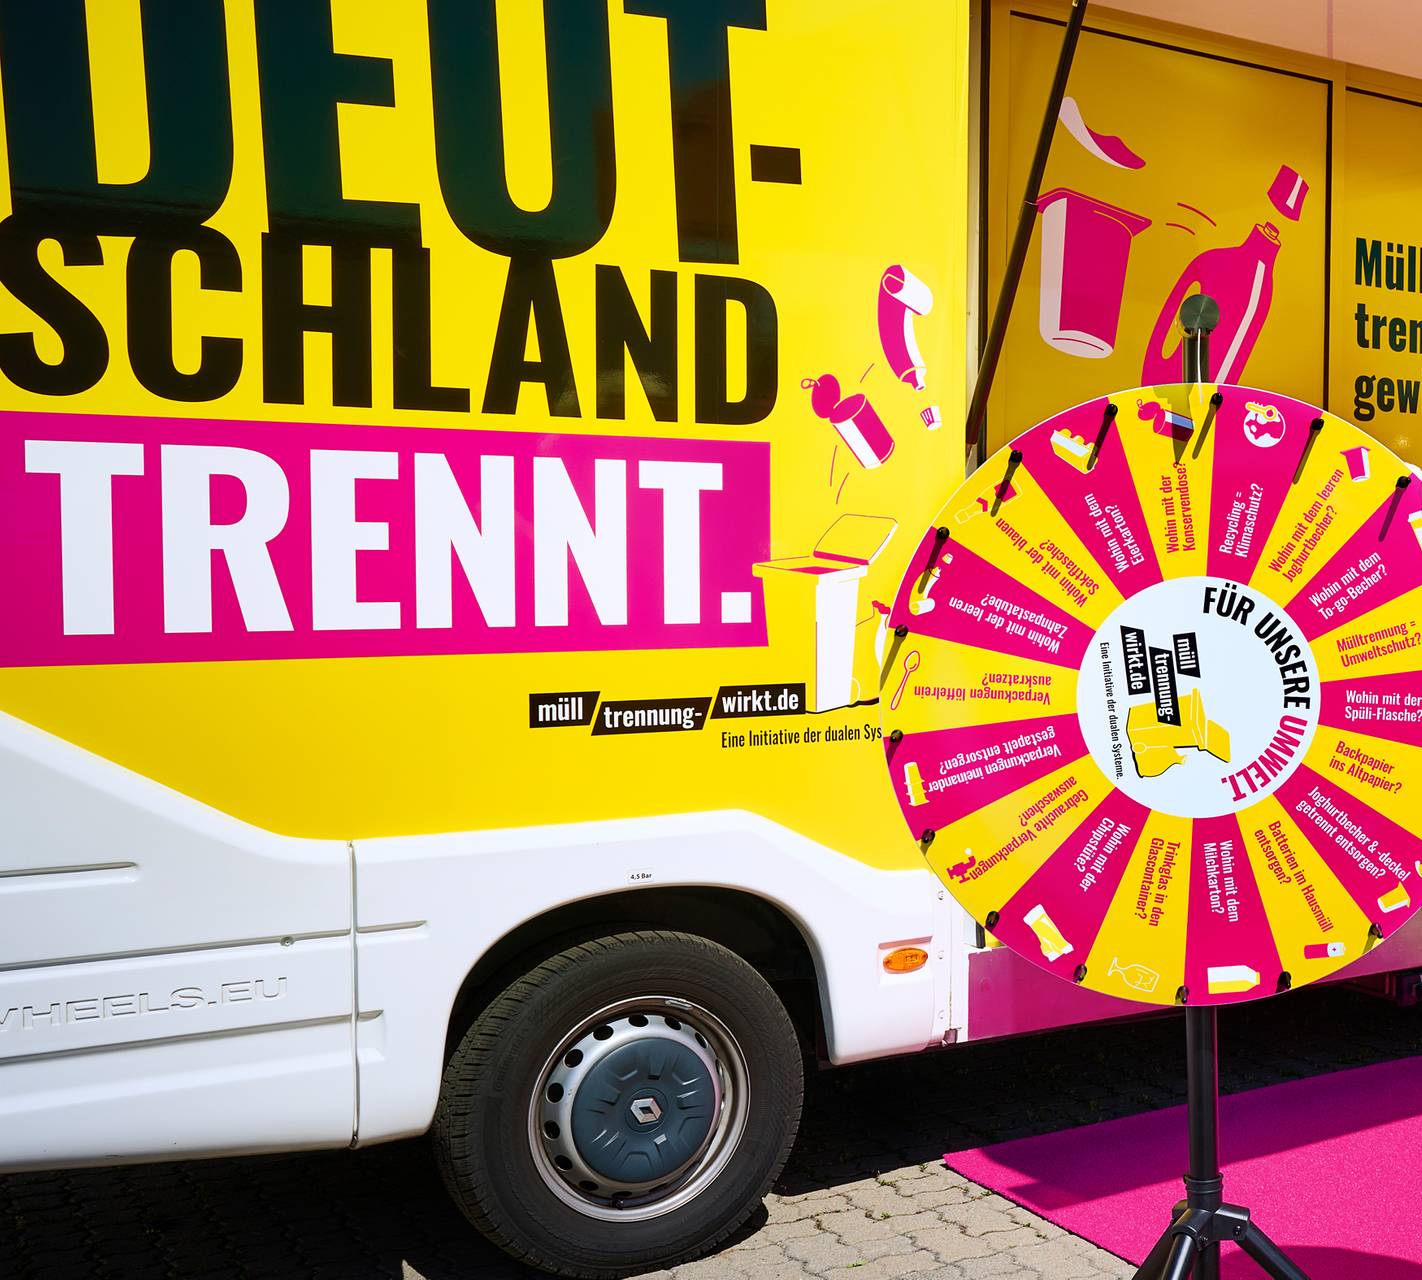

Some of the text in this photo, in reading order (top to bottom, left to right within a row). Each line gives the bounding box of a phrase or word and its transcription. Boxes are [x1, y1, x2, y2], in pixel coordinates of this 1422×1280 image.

[0, 0, 801, 265] DEUT-
[0, 212, 779, 425] SCHLAND
[24, 440, 752, 637] TRENNT.
[1084, 493, 1130, 573] Wohin mit dem
[1104, 504, 1145, 565] Eierkarton?
[1159, 475, 1180, 554] Wohin mit der
[1172, 461, 1196, 552] Konservendose?
[1218, 500, 1246, 554] Recycling
[1234, 483, 1263, 558] Klimaschutz?
[1267, 469, 1344, 572] Wohin mit dem leeren
[995, 517, 1088, 608] Wohin mit der blauen
[1038, 539, 1099, 595] Sektflasche?
[1281, 505, 1337, 583] Joghurtbecher?
[1308, 552, 1381, 607] Wohin mit dem
[1317, 563, 1387, 620] To-go-Becher?
[948, 596, 1060, 654] Wohin mit der leeren
[980, 593, 1068, 639] Zahnpastatube?
[1336, 622, 1409, 652] Mülltrennung
[1340, 631, 1421, 667] Umweltschutz?
[537, 688, 799, 730] müll trennung- wirkt.de
[913, 686, 1050, 705] Verpackungen löffelrein
[981, 673, 1051, 688] auskratzen?
[1100, 641, 1124, 779] Eine Initiative der dualen Systeme.
[1125, 631, 1196, 722] müll trennung- wirkt.de
[1203, 582, 1311, 802] FÜR UNSERE UMWELT.
[1346, 689, 1379, 704] Wohin
[1382, 692, 1400, 705] mit
[1403, 693, 1422, 706] der
[721, 731, 745, 748] Eine
[749, 727, 800, 747] Initiative
[803, 727, 821, 744] der
[825, 725, 861, 742] dualen
[928, 743, 1062, 792] Verpackungen ineinander
[939, 725, 1055, 775] gestapelt entsorgen?
[1335, 740, 1395, 774] Backpapier
[1018, 776, 1077, 827] auswaschen?
[1328, 755, 1402, 794] ins Altpapier?
[969, 789, 1089, 880] Gebrauchte Verpackungen
[1073, 817, 1115, 872] Chipstüte?
[1079, 823, 1131, 892] Wohin mit der
[1254, 829, 1292, 884] entsorgen?
[1295, 800, 1386, 879] getrennt entsorgen?
[1307, 786, 1367, 841] Joghurtbecher
[1377, 851, 1411, 881] -deckel
[1134, 837, 1165, 920] Glascontainer?
[1148, 841, 1181, 927] Trinkglas in den
[1203, 842, 1225, 914] Milchkarton?
[1219, 839, 1240, 922] Wohin mit dem
[1267, 820, 1334, 933] Batterien im Hausmüll
